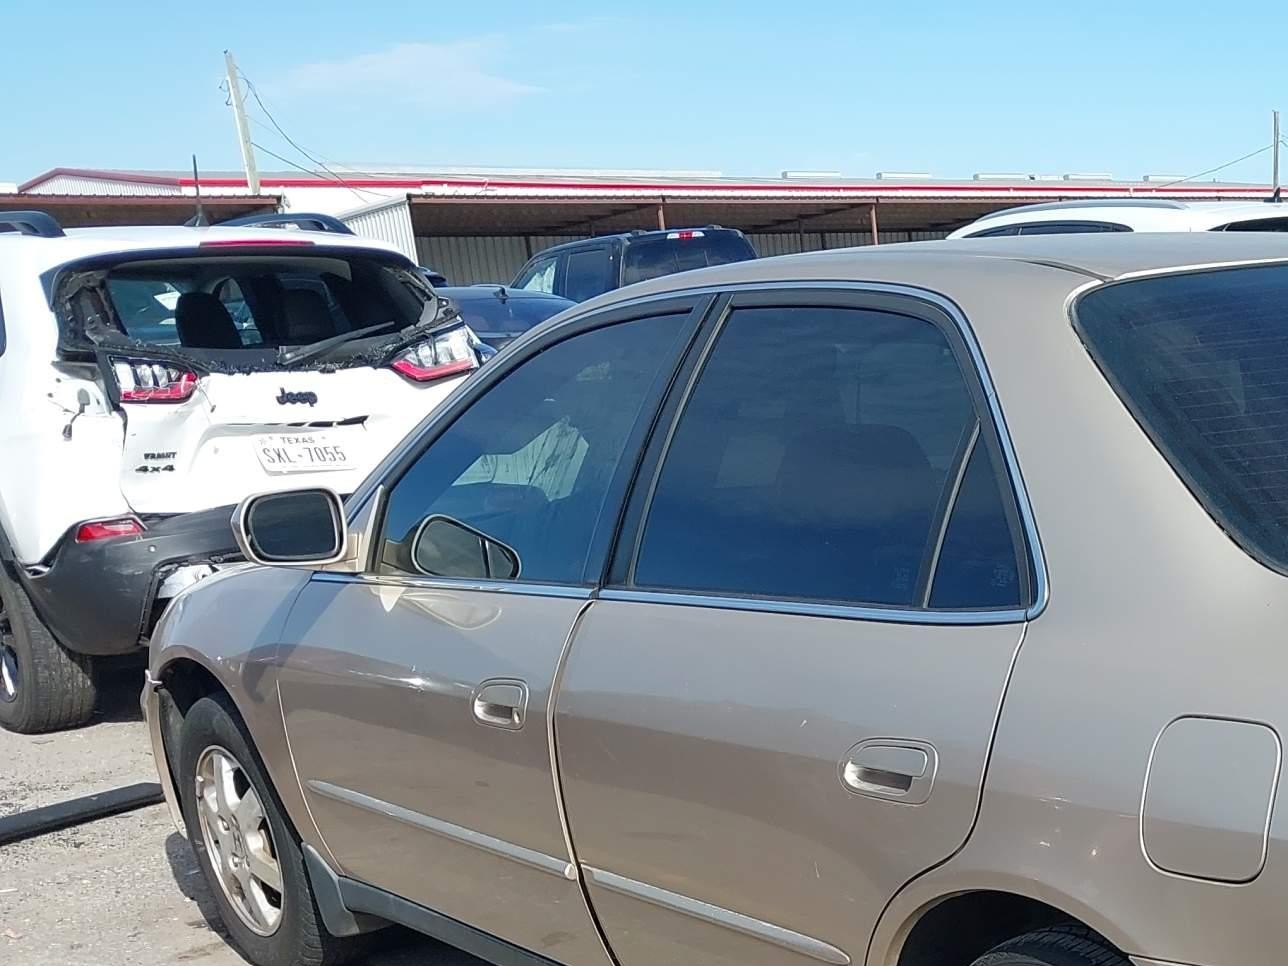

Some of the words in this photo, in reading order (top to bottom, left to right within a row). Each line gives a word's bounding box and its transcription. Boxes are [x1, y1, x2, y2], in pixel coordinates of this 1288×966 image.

[275, 386, 318, 407] Jeep
[280, 436, 316, 445] TEXAS
[135, 464, 175, 473] 4x4
